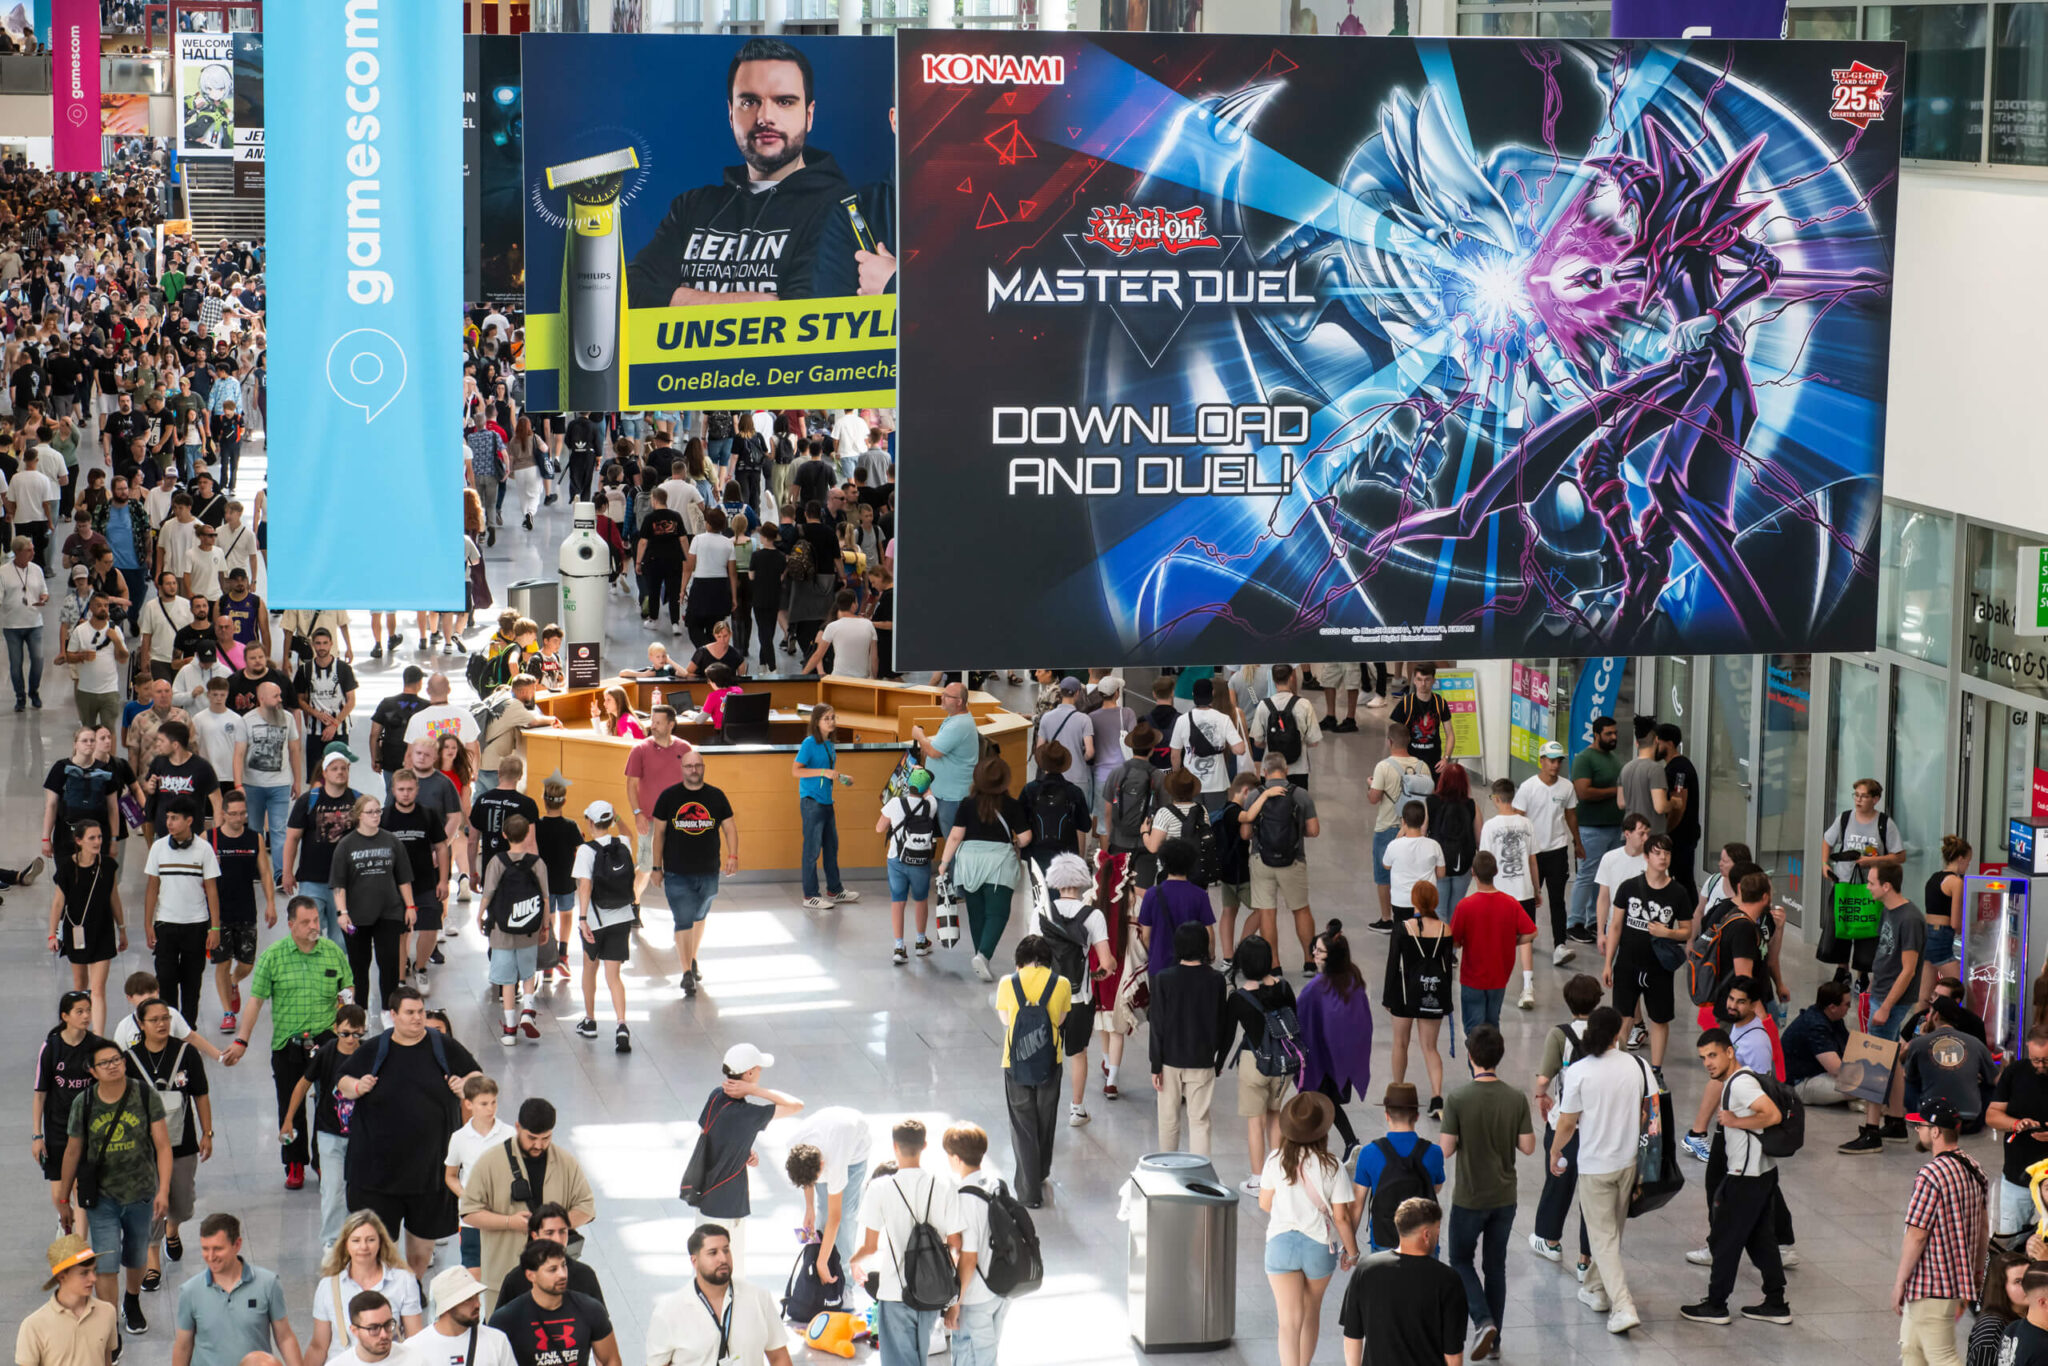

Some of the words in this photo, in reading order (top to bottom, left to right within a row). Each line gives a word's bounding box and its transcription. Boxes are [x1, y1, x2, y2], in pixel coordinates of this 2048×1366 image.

[71, 26, 84, 99] gamescom
[182, 48, 222, 60] HALL
[922, 54, 1065, 85] KONAMI
[1834, 71, 1883, 80] YU-GI-OH!
[245, 149, 265, 159] AN
[345, 0, 394, 305] gamescom
[1103, 218, 1202, 239] Yu-Gi-Oh!
[576, 272, 611, 281] PHILIPS
[988, 266, 1184, 313] MASTER
[1188, 257, 1317, 303] DUEL
[656, 316, 787, 351] UNSER
[657, 369, 761, 392] OneBlade.
[767, 367, 804, 386] Der
[992, 405, 1310, 445] DOWNLOAD
[1008, 456, 1121, 496] AND
[1137, 455, 1292, 495] DUEL!
[1970, 592, 2009, 627] Tabak
[1968, 634, 2021, 673] Tobacco
[2024, 651, 2036, 676] &
[513, 894, 540, 919] NIKE
[1838, 897, 1876, 906] MERCH
[1838, 906, 1862, 914] FOR
[1838, 914, 1877, 923] NERDS
[1015, 1023, 1049, 1062] NIKE
